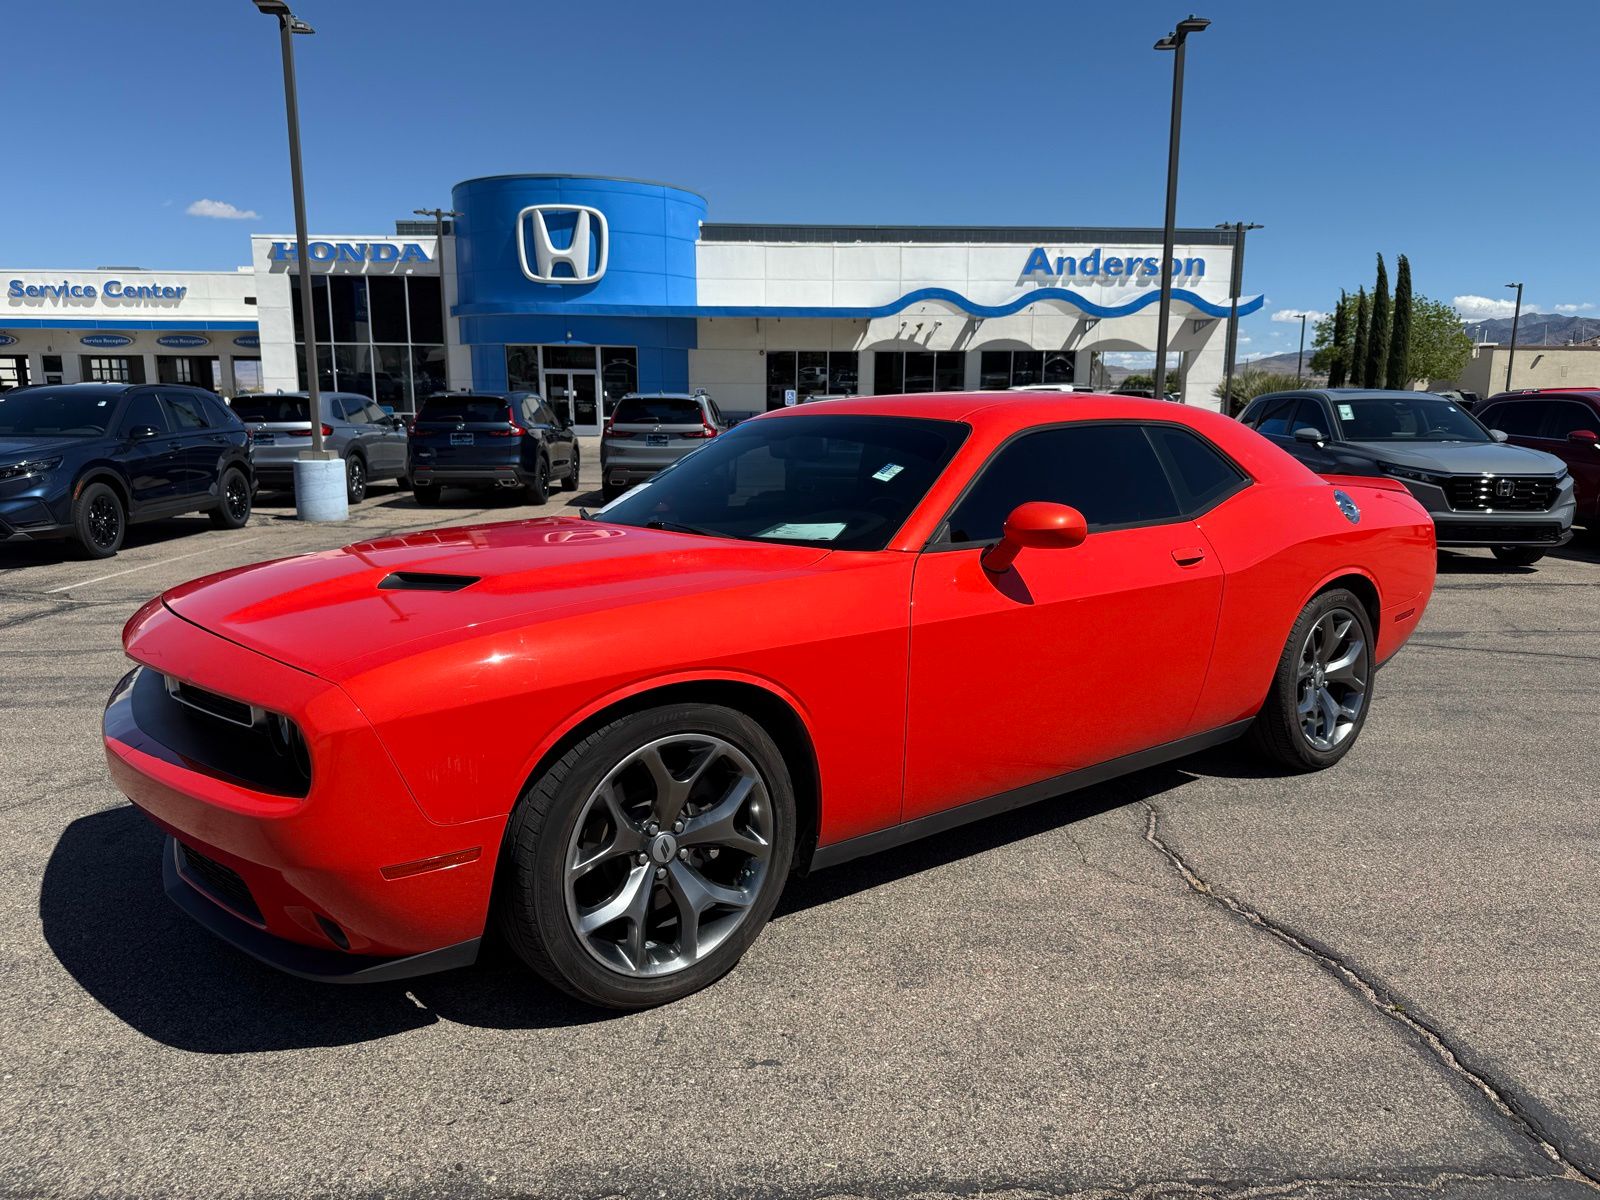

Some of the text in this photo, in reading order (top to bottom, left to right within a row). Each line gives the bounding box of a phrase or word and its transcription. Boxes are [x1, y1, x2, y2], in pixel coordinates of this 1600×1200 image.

[272, 241, 435, 263] HONDA
[8, 279, 187, 299] Service Center
